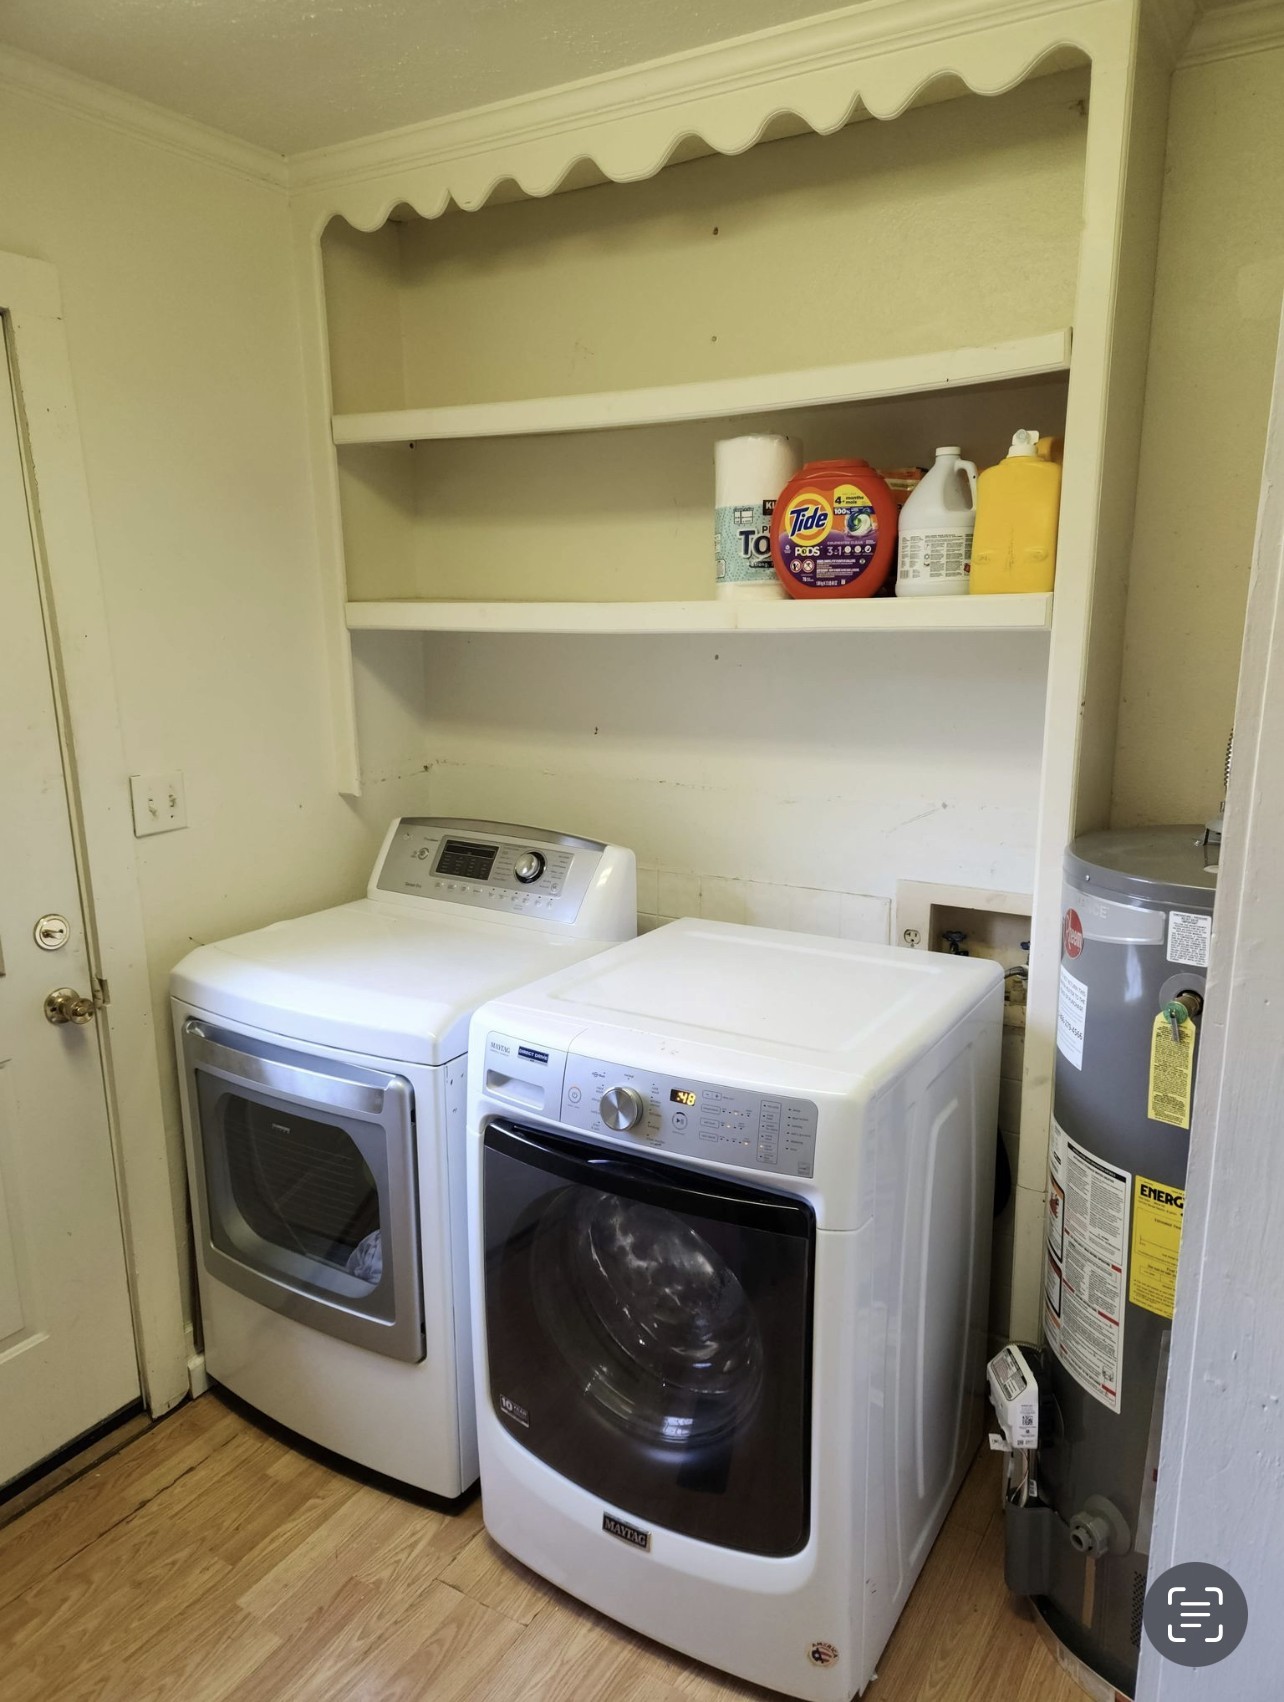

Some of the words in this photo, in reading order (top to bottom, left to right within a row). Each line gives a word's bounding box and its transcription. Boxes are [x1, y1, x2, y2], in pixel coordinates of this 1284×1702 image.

[790, 505, 829, 538] Tide
[794, 546, 821, 557] PODS
[490, 1042, 511, 1054] MAYTAG
[518, 1048, 534, 1057] DIRECT
[1141, 1183, 1185, 1209] ENERG
[501, 1397, 513, 1412] 10
[605, 1518, 647, 1546] MAYTAG
